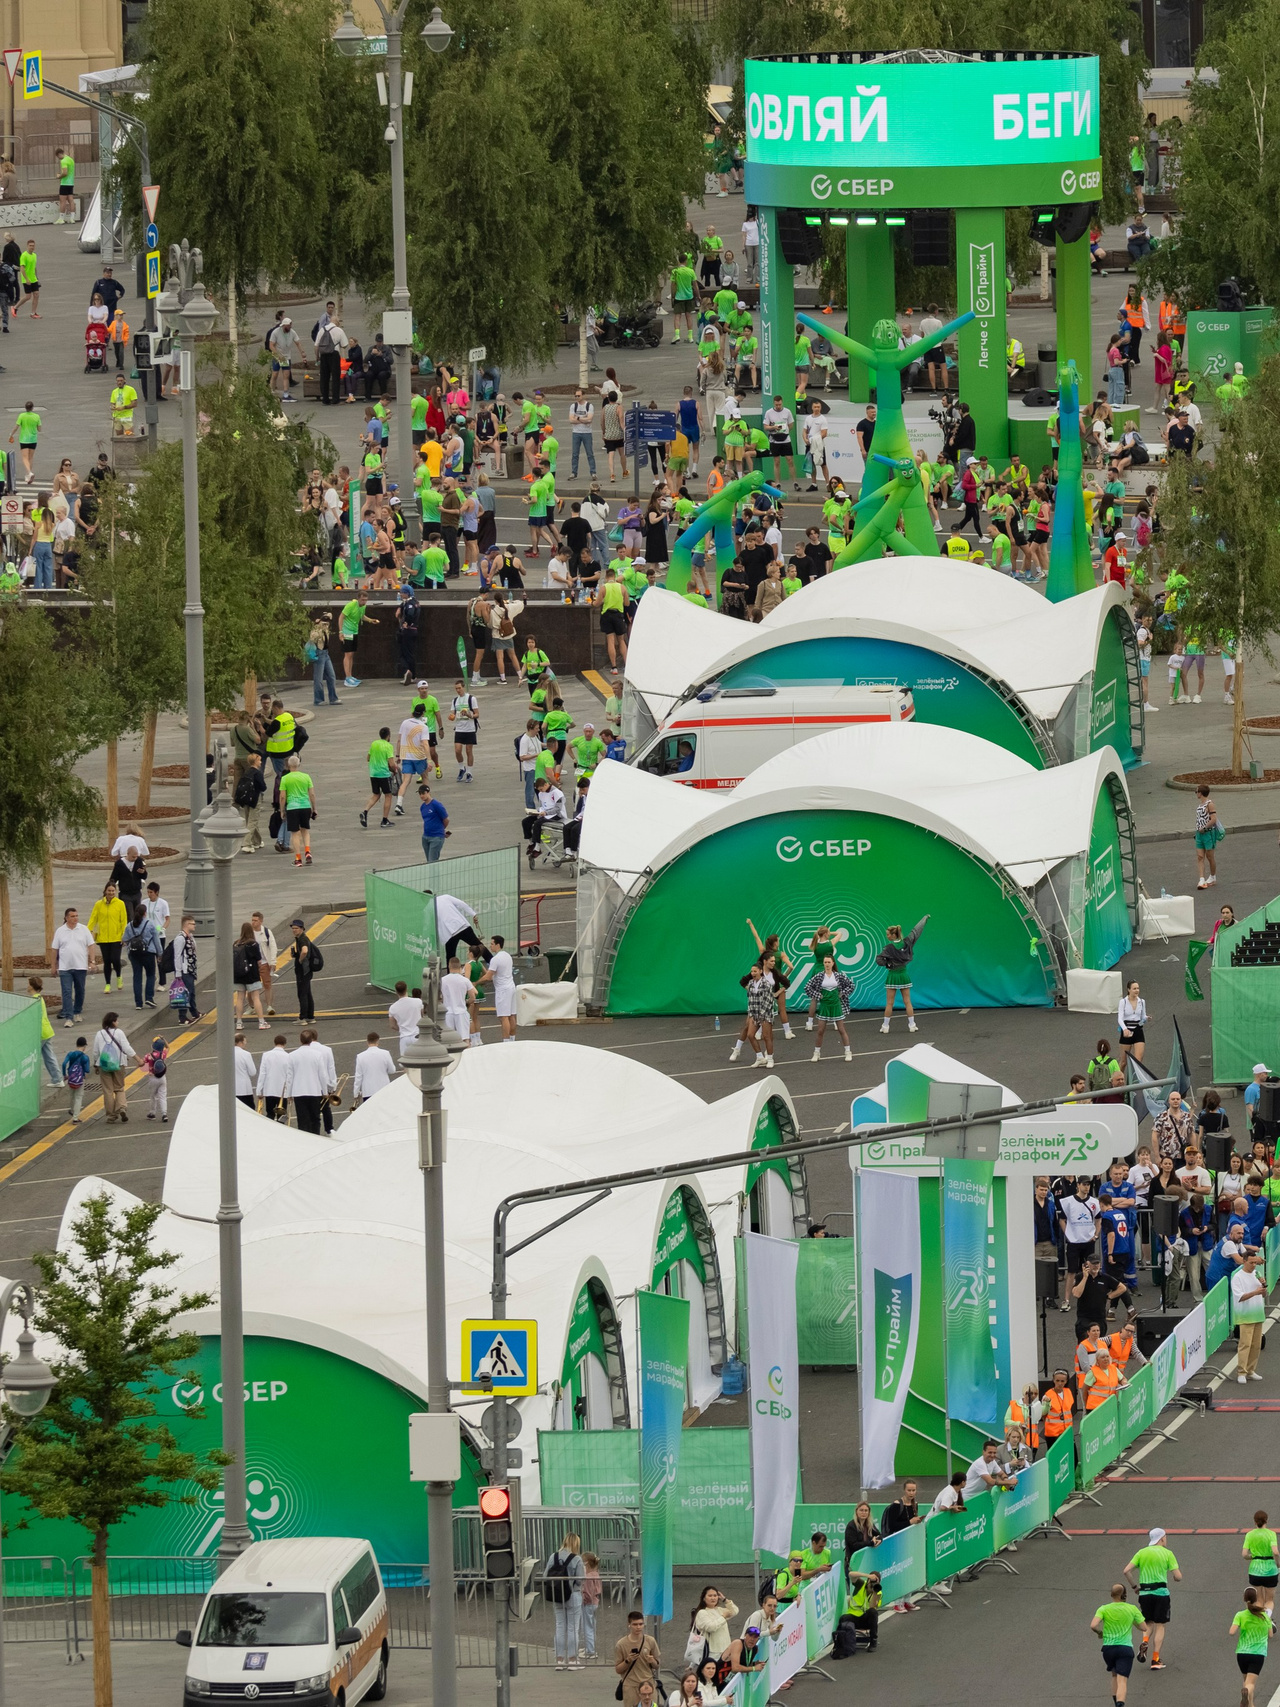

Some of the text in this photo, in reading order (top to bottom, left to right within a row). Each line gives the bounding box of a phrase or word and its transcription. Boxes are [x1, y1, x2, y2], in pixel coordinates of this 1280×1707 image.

[748, 85, 888, 142] ОВЛЯЙ
[993, 90, 1091, 140] БЕГИ
[837, 179, 894, 196] СБЕР
[1079, 171, 1100, 189] СБЕР
[976, 254, 990, 295] Прайм
[1207, 323, 1230, 331] СБЕР
[978, 331, 989, 369] Легче
[809, 839, 872, 857] СБЕР
[890, 1141, 926, 1156] Пра
[1001, 1133, 1066, 1148] зелёный
[947, 1191, 987, 1207] марафо
[885, 1289, 902, 1361] Прайм
[646, 1360, 685, 1378] зелёный
[646, 1373, 684, 1391] марафон
[756, 1400, 792, 1421] СБЕР
[689, 1481, 749, 1495] зелёный
[588, 1491, 744, 1511] Прайм марафон
[940, 1537, 955, 1552] Прайм
[814, 1576, 837, 1619] БЕГИ
